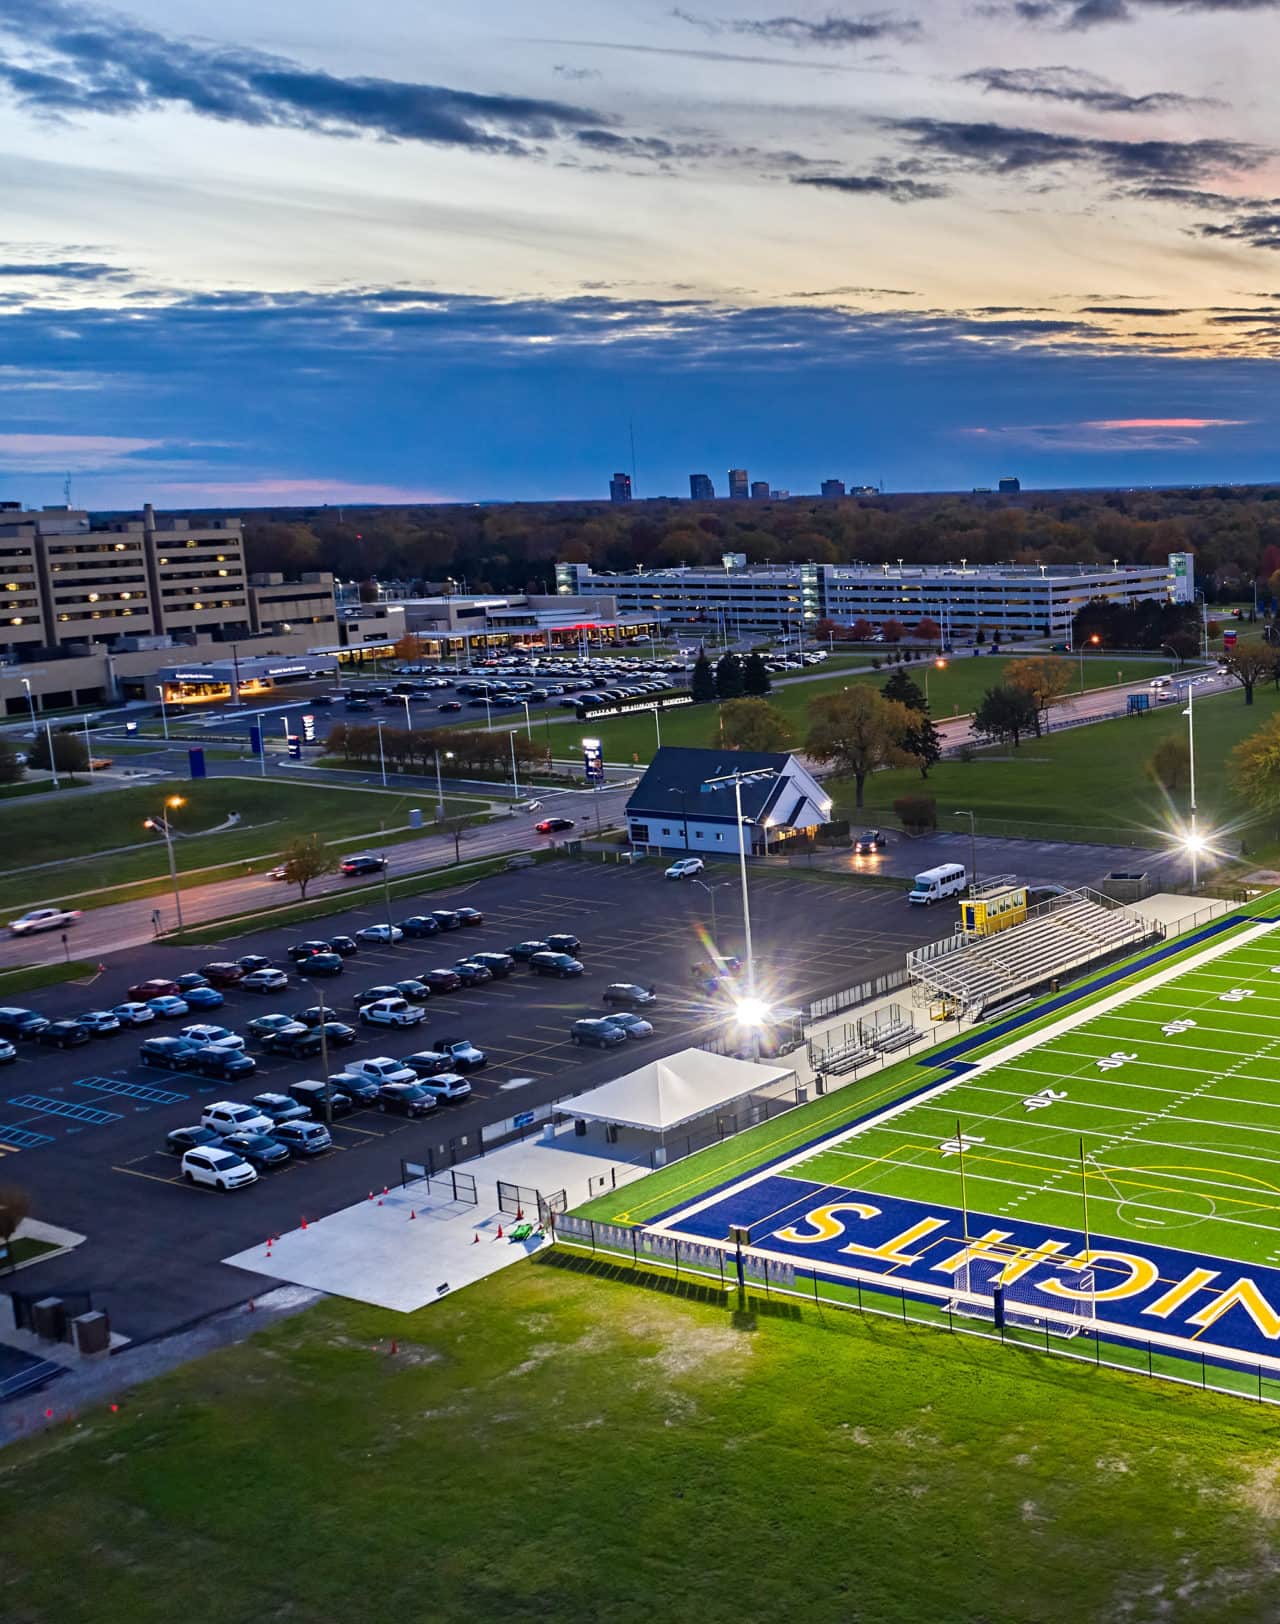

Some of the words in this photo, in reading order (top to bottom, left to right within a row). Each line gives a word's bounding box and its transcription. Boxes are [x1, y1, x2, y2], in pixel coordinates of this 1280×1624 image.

[1218, 988, 1257, 1002] 50
[1161, 1018, 1197, 1034] 40
[1096, 1051, 1139, 1069] 30
[1022, 1089, 1069, 1109] 20
[938, 1133, 986, 1155] 10
